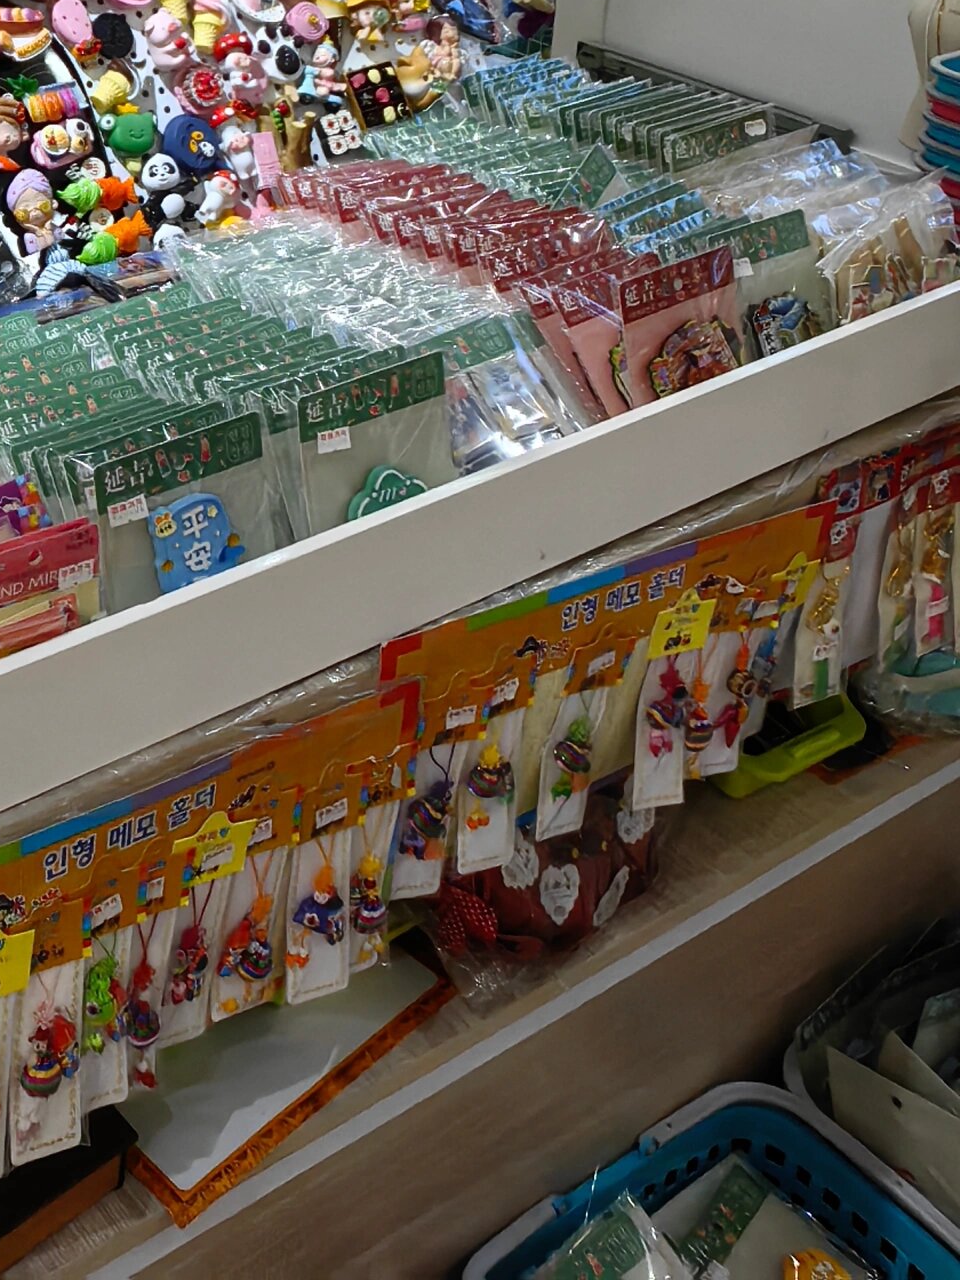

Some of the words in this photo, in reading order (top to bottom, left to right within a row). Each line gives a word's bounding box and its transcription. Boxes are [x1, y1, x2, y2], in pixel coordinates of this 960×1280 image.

[625, 279, 654, 308] 延吉
[105, 460, 146, 495] 延吉
[181, 504, 212, 572] 平安
[562, 594, 599, 632] 인형
[605, 580, 641, 612] 메모
[648, 563, 687, 601] 홀더
[44, 833, 97, 883] 인형
[107, 810, 158, 851] 메모
[167, 782, 217, 832] 홀더
